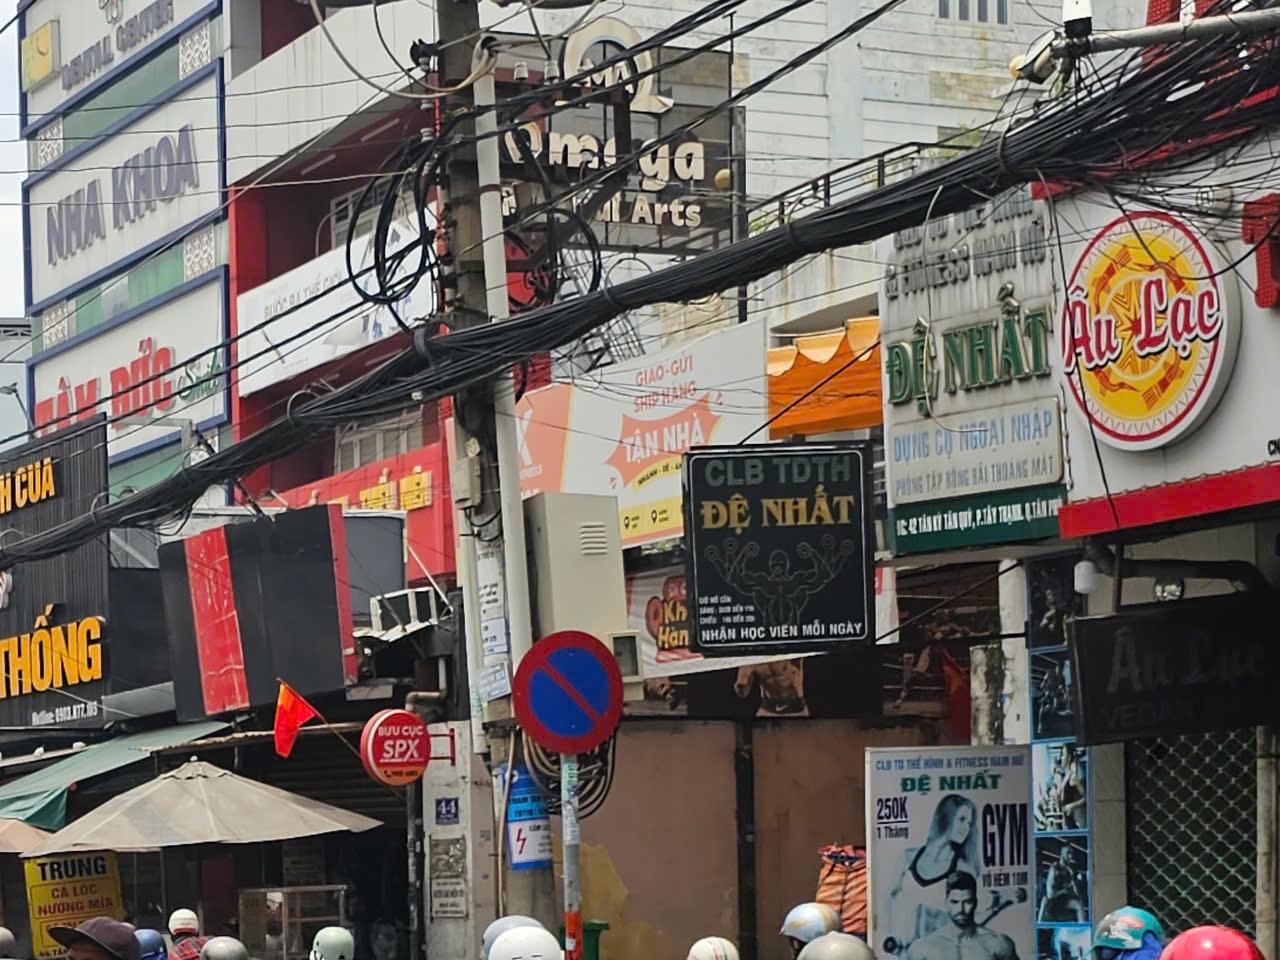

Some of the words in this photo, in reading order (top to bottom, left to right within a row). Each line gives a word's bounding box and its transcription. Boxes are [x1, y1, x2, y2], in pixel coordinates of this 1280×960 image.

[47, 179, 106, 266] NHA
[112, 123, 200, 229] KHOA
[631, 193, 702, 227] Arts
[1062, 284, 1122, 371] Âu
[1134, 275, 1222, 357] Lạc
[634, 390, 660, 413] SHIP
[623, 428, 660, 464] TẬN
[663, 412, 706, 453] NHÀ
[894, 430, 930, 465] DỤNG
[1011, 408, 1053, 446] NHẬP
[14, 457, 56, 508] CUA
[704, 459, 765, 487] CLB
[772, 455, 851, 485] TDTH
[700, 493, 752, 535] ĐỆ
[702, 625, 736, 643] NHẬN
[740, 626, 766, 641] HỌC
[802, 618, 825, 636] MỖI
[829, 619, 862, 636] NGÀY
[378, 726, 402, 738] BƯU
[404, 725, 424, 738] CỤC
[383, 740, 419, 760] SPX
[876, 759, 891, 771] CLB
[955, 757, 988, 768] FITNESS
[901, 774, 931, 795] ĐỆ
[939, 770, 1001, 790] NHẤT
[437, 800, 457, 814] 44
[877, 797, 908, 820] 250K
[877, 827, 881, 839] 1
[885, 825, 909, 840] Tháng
[982, 803, 1028, 867] GYM
[37, 857, 107, 881] TRUNG
[51, 883, 69, 900] CÁ
[88, 896, 114, 910] MÍA
